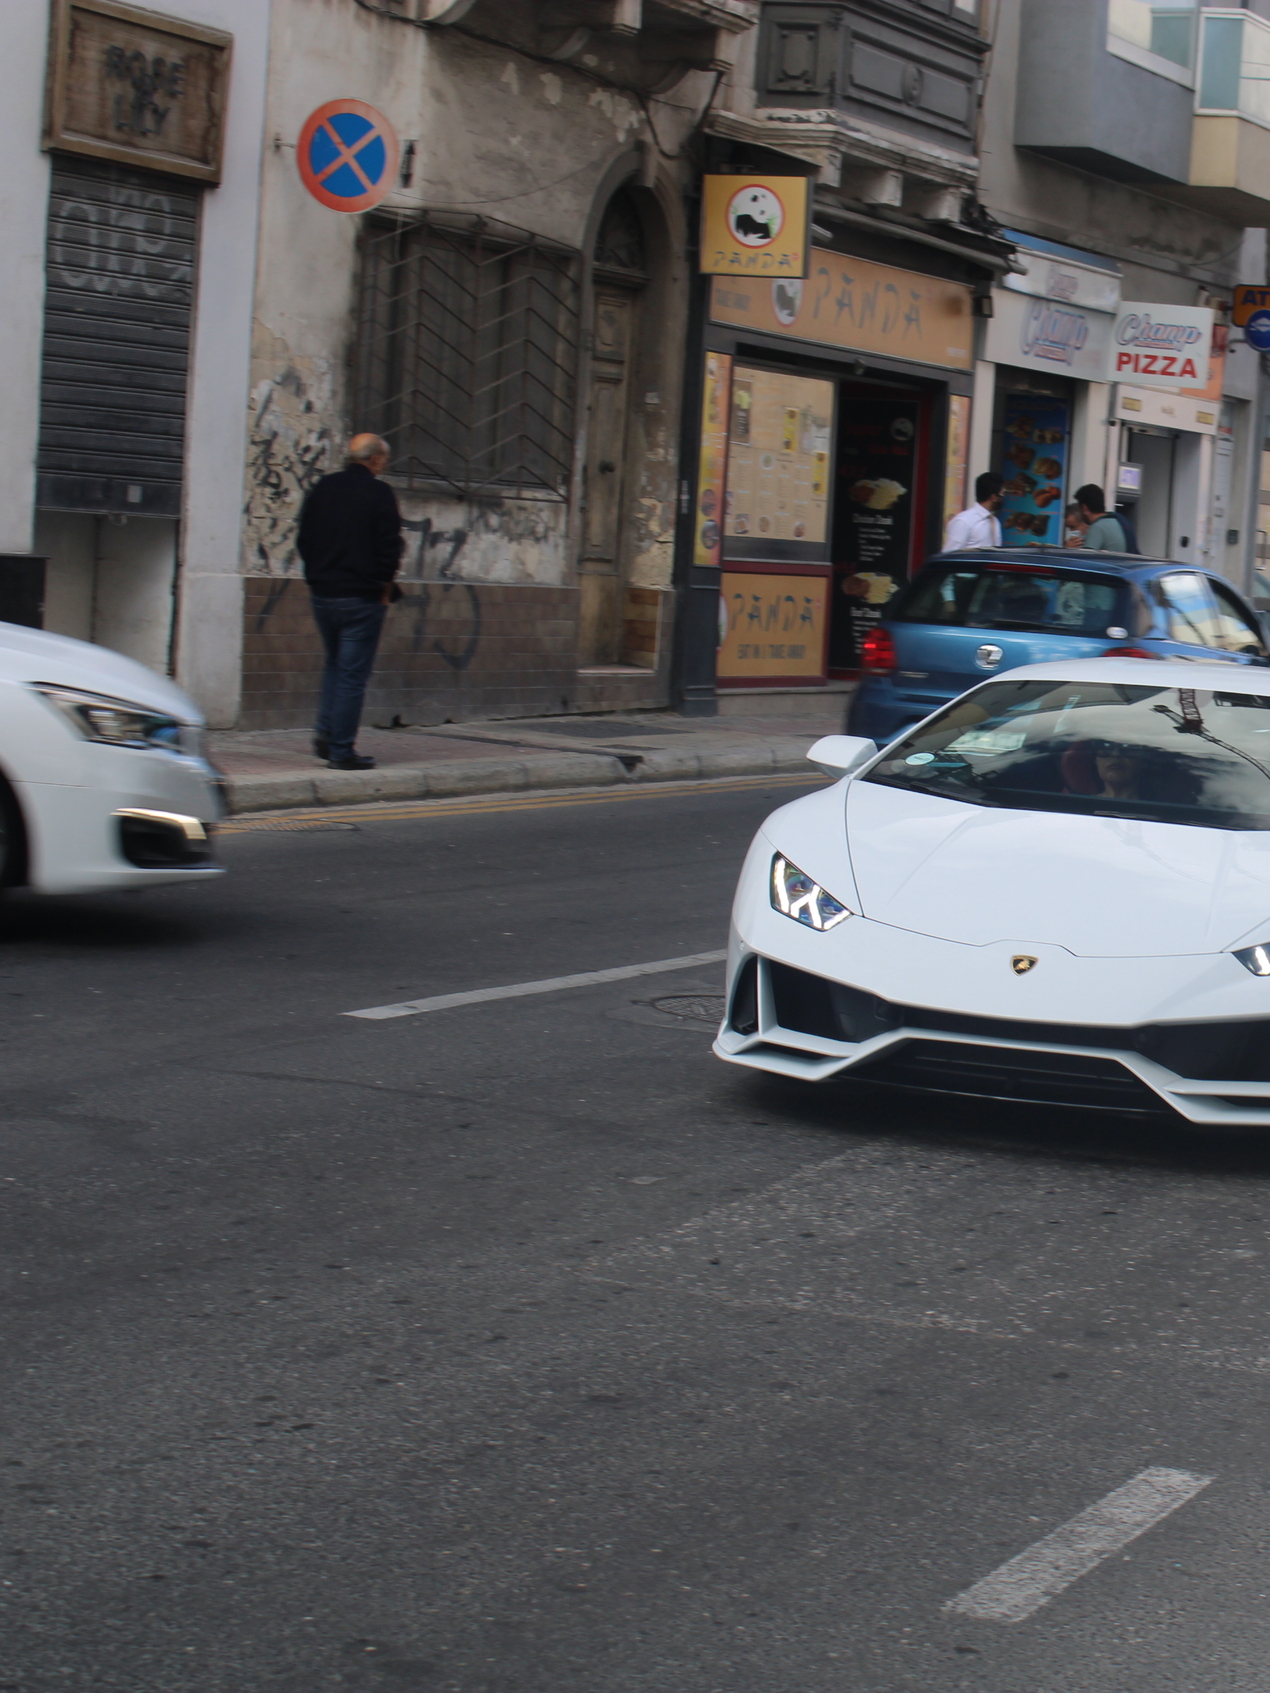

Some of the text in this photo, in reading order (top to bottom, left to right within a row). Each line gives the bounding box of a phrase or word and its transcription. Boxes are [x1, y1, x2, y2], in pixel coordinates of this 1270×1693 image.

[812, 267, 923, 340] PANDA
[1115, 312, 1203, 352] Champ
[1115, 352, 1198, 378] PIZZA
[729, 592, 816, 636] PANDA
